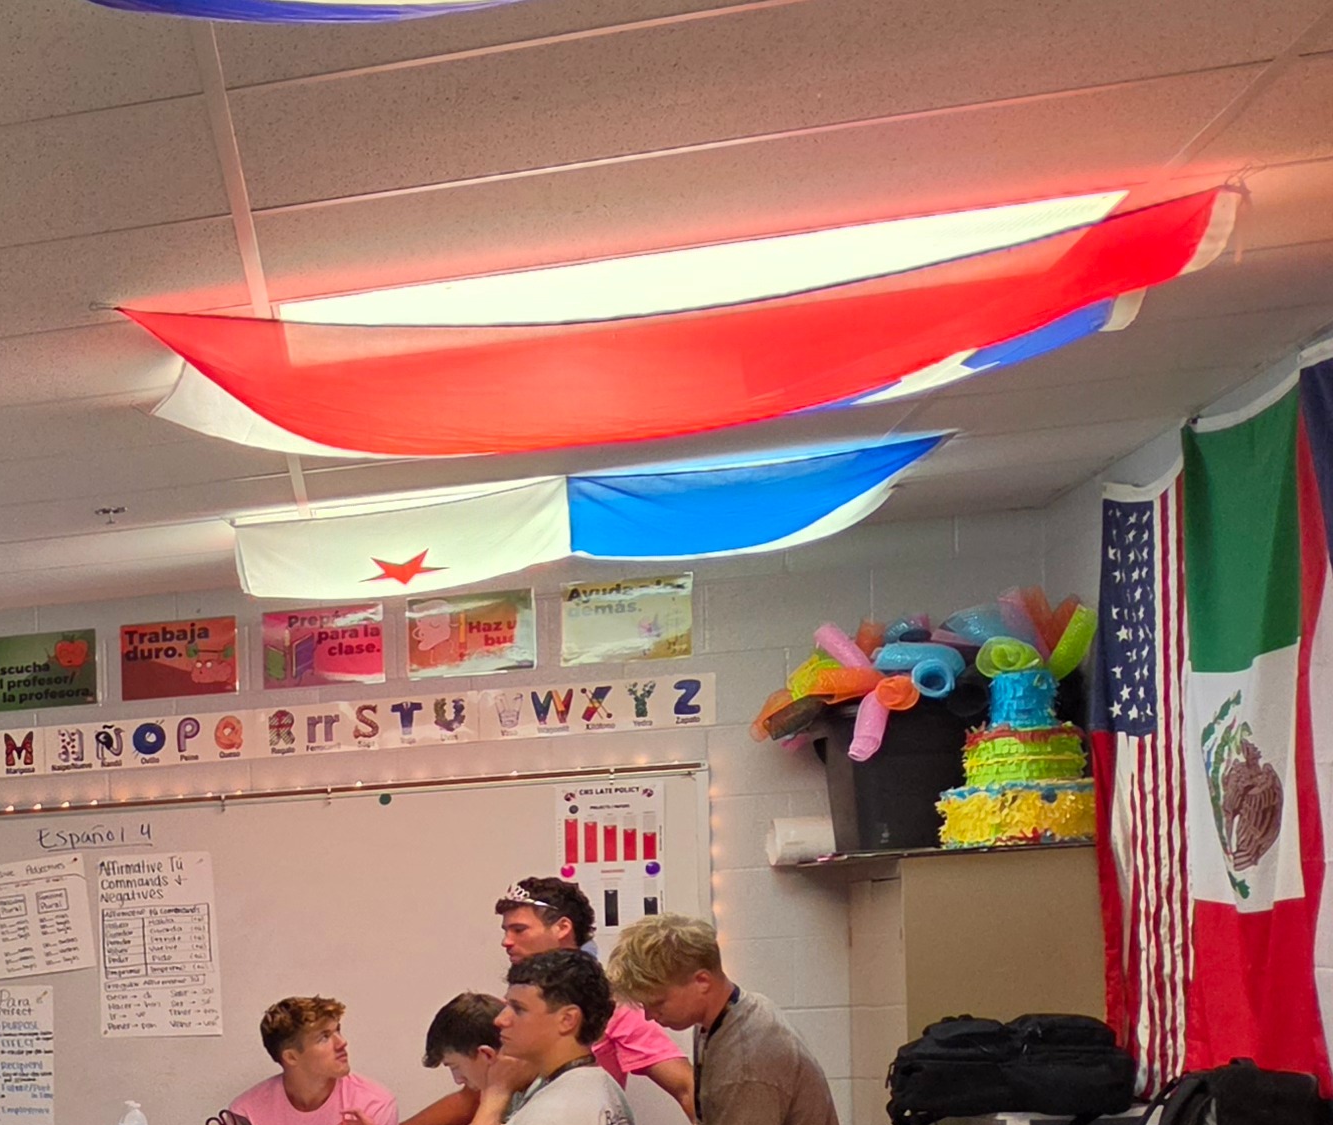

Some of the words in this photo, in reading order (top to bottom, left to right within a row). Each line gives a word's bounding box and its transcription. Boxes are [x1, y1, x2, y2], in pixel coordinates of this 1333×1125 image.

[124, 624, 210, 647] Trabaja
[317, 628, 359, 645] para
[363, 625, 380, 639] la
[468, 620, 502, 634] Haz
[125, 644, 183, 663] duro.
[327, 642, 381, 657] clase.
[7, 671, 76, 692] profesor/
[2, 690, 16, 703] la
[595, 787, 613, 795] LATE
[36, 825, 124, 849] Español
[140, 823, 152, 840] 4
[98, 861, 163, 876] Affirmative
[168, 855, 183, 874] Tú
[101, 874, 169, 891] Commands
[100, 888, 164, 908] Negatives
[0, 988, 31, 1009] Para
